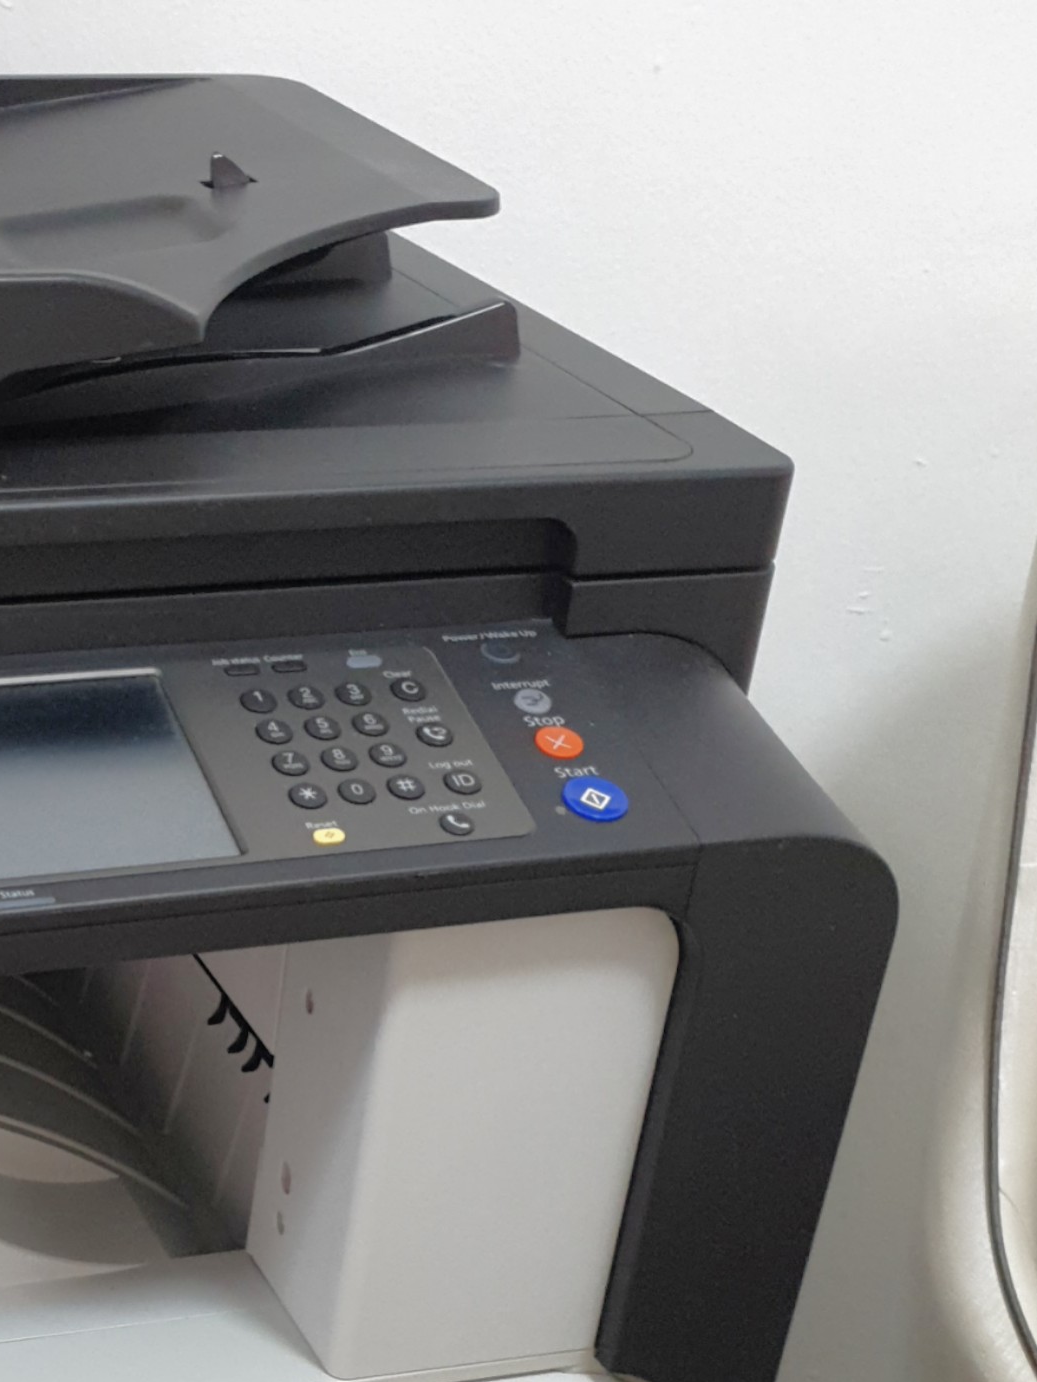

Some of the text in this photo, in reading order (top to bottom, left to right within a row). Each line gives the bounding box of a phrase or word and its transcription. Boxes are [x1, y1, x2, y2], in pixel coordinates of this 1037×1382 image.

[346, 684, 361, 696] 3
[401, 681, 419, 694] C
[490, 679, 551, 691] Interrupt
[299, 687, 311, 698] 2
[315, 717, 329, 729] 5
[362, 713, 377, 725] 6
[523, 715, 566, 728] Stop
[267, 721, 279, 733] 4
[331, 748, 345, 760] 8
[380, 744, 394, 756] 9
[554, 765, 600, 779] Start
[451, 773, 475, 787] ID
